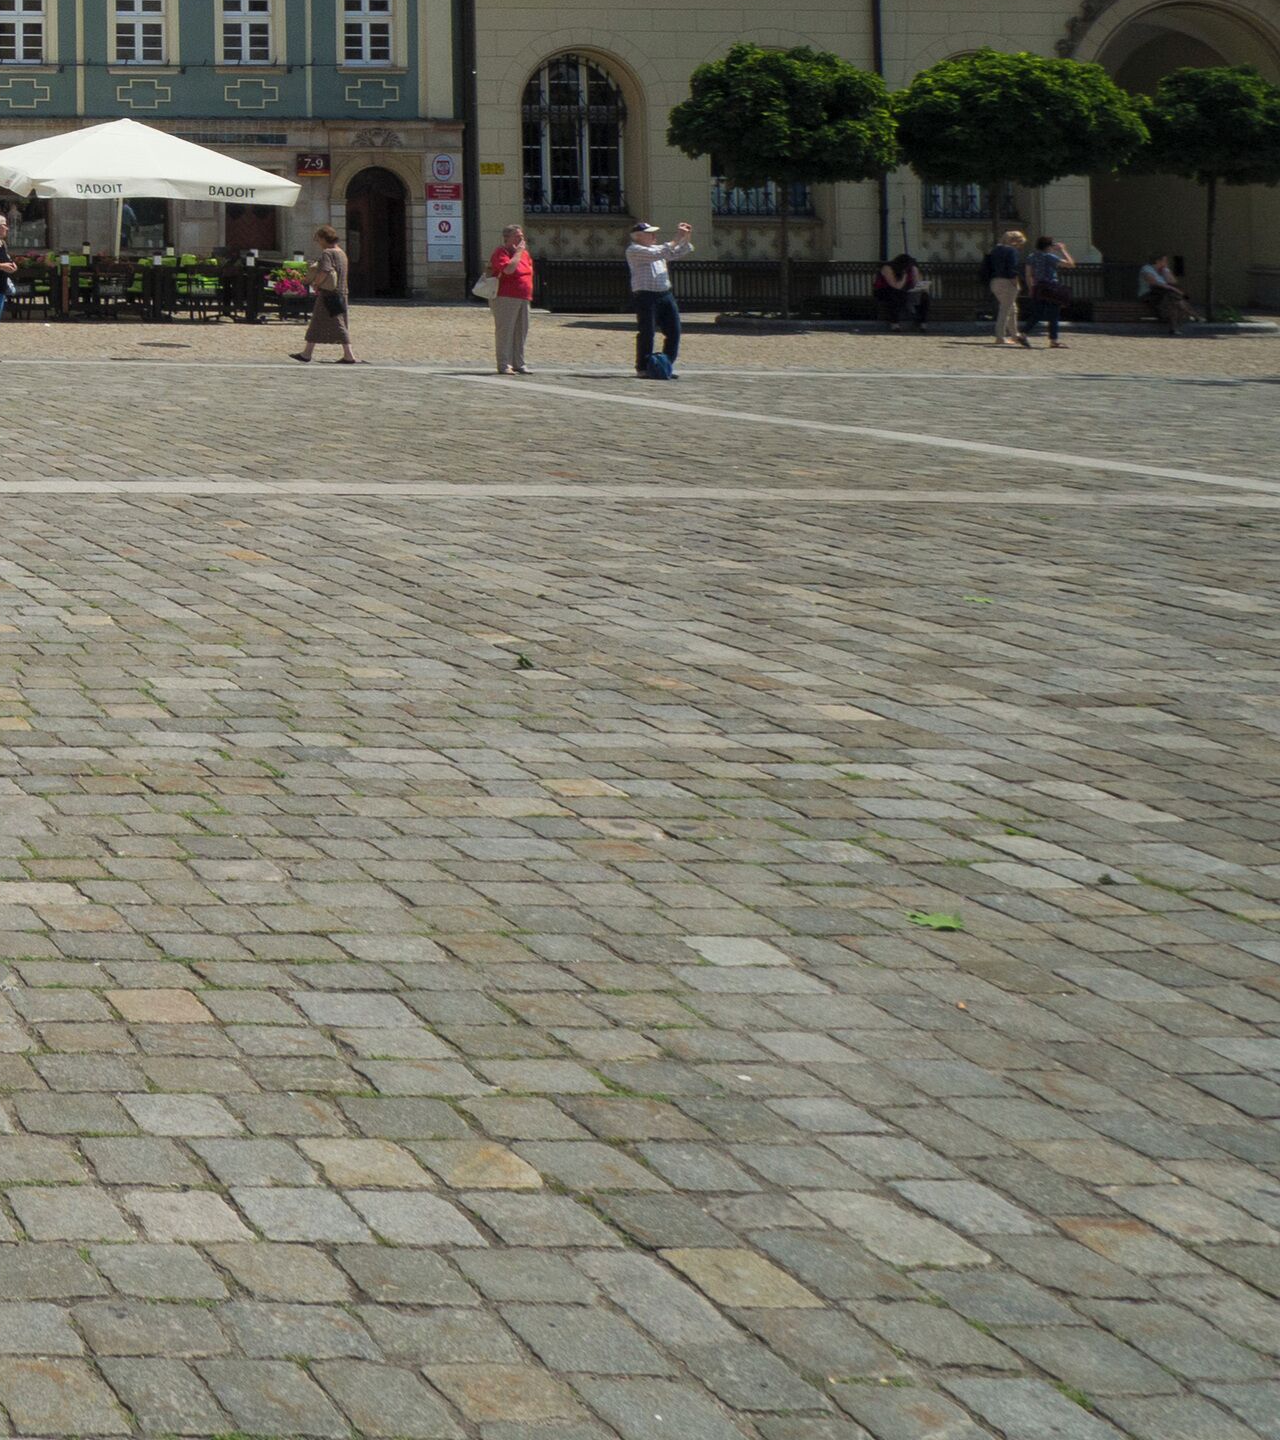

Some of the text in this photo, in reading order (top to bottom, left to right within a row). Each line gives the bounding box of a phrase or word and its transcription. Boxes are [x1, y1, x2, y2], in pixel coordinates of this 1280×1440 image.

[304, 158, 324, 170] 7-9
[76, 183, 123, 194] BADOIT
[208, 185, 256, 198] BADOIT
